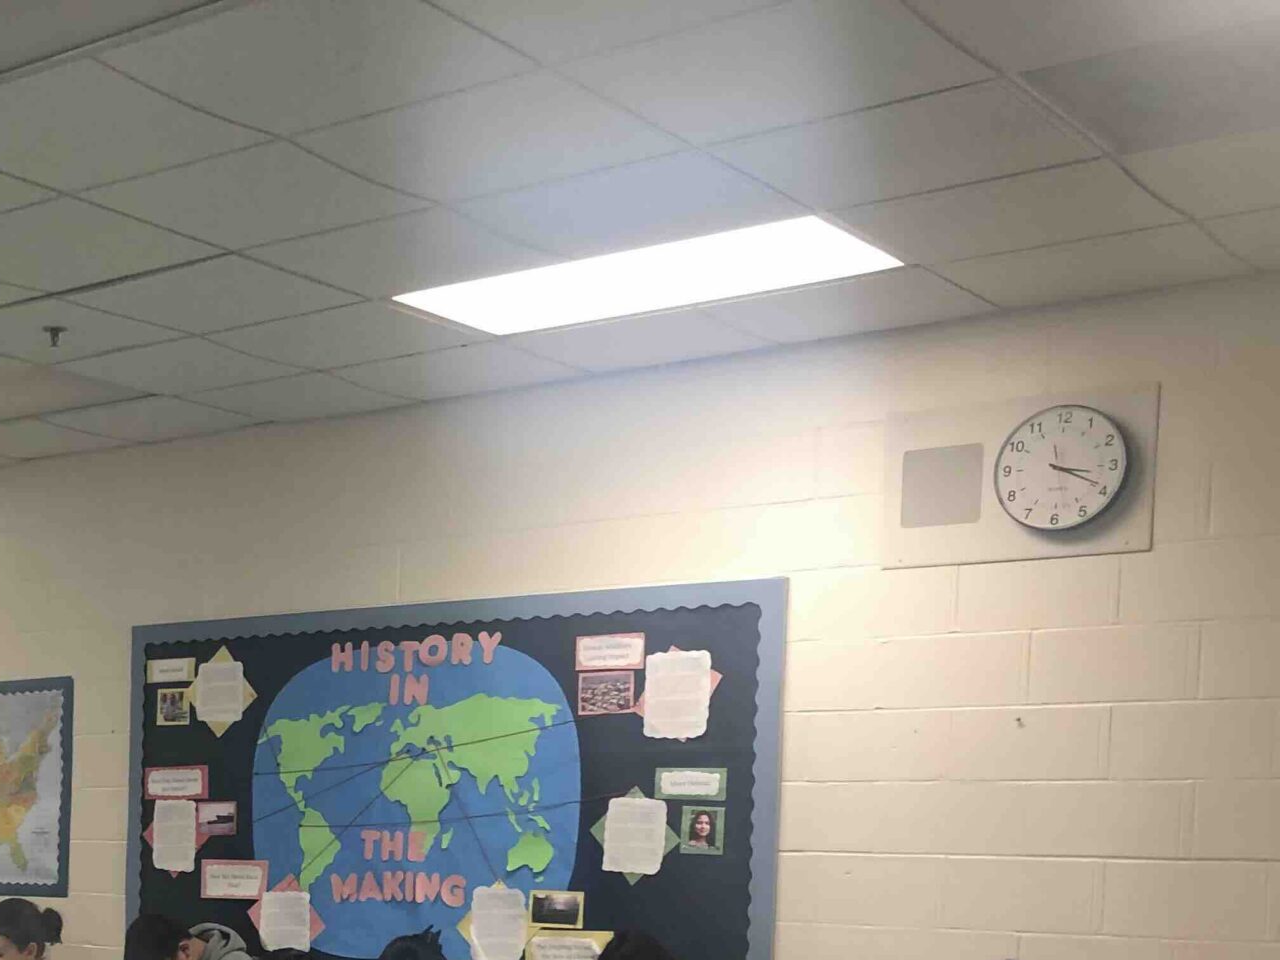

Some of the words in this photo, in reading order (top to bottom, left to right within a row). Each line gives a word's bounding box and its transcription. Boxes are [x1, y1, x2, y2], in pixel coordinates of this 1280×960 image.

[1057, 411, 1073, 424] 12
[1088, 416, 1094, 429] 1
[1029, 421, 1042, 434] 11
[1009, 440, 1025, 453] 10
[1104, 434, 1115, 446] 2
[1002, 465, 1012, 477] 9
[1108, 459, 1118, 471] 3
[1007, 490, 1016, 502] 8
[1098, 485, 1108, 497] 4
[1023, 508, 1033, 520] 7
[1078, 505, 1087, 518] 5
[1050, 513, 1059, 525] 6
[331, 631, 502, 673] HISTORY
[388, 674, 429, 705] IN
[361, 830, 426, 861] THE
[330, 871, 466, 907] MAKING
